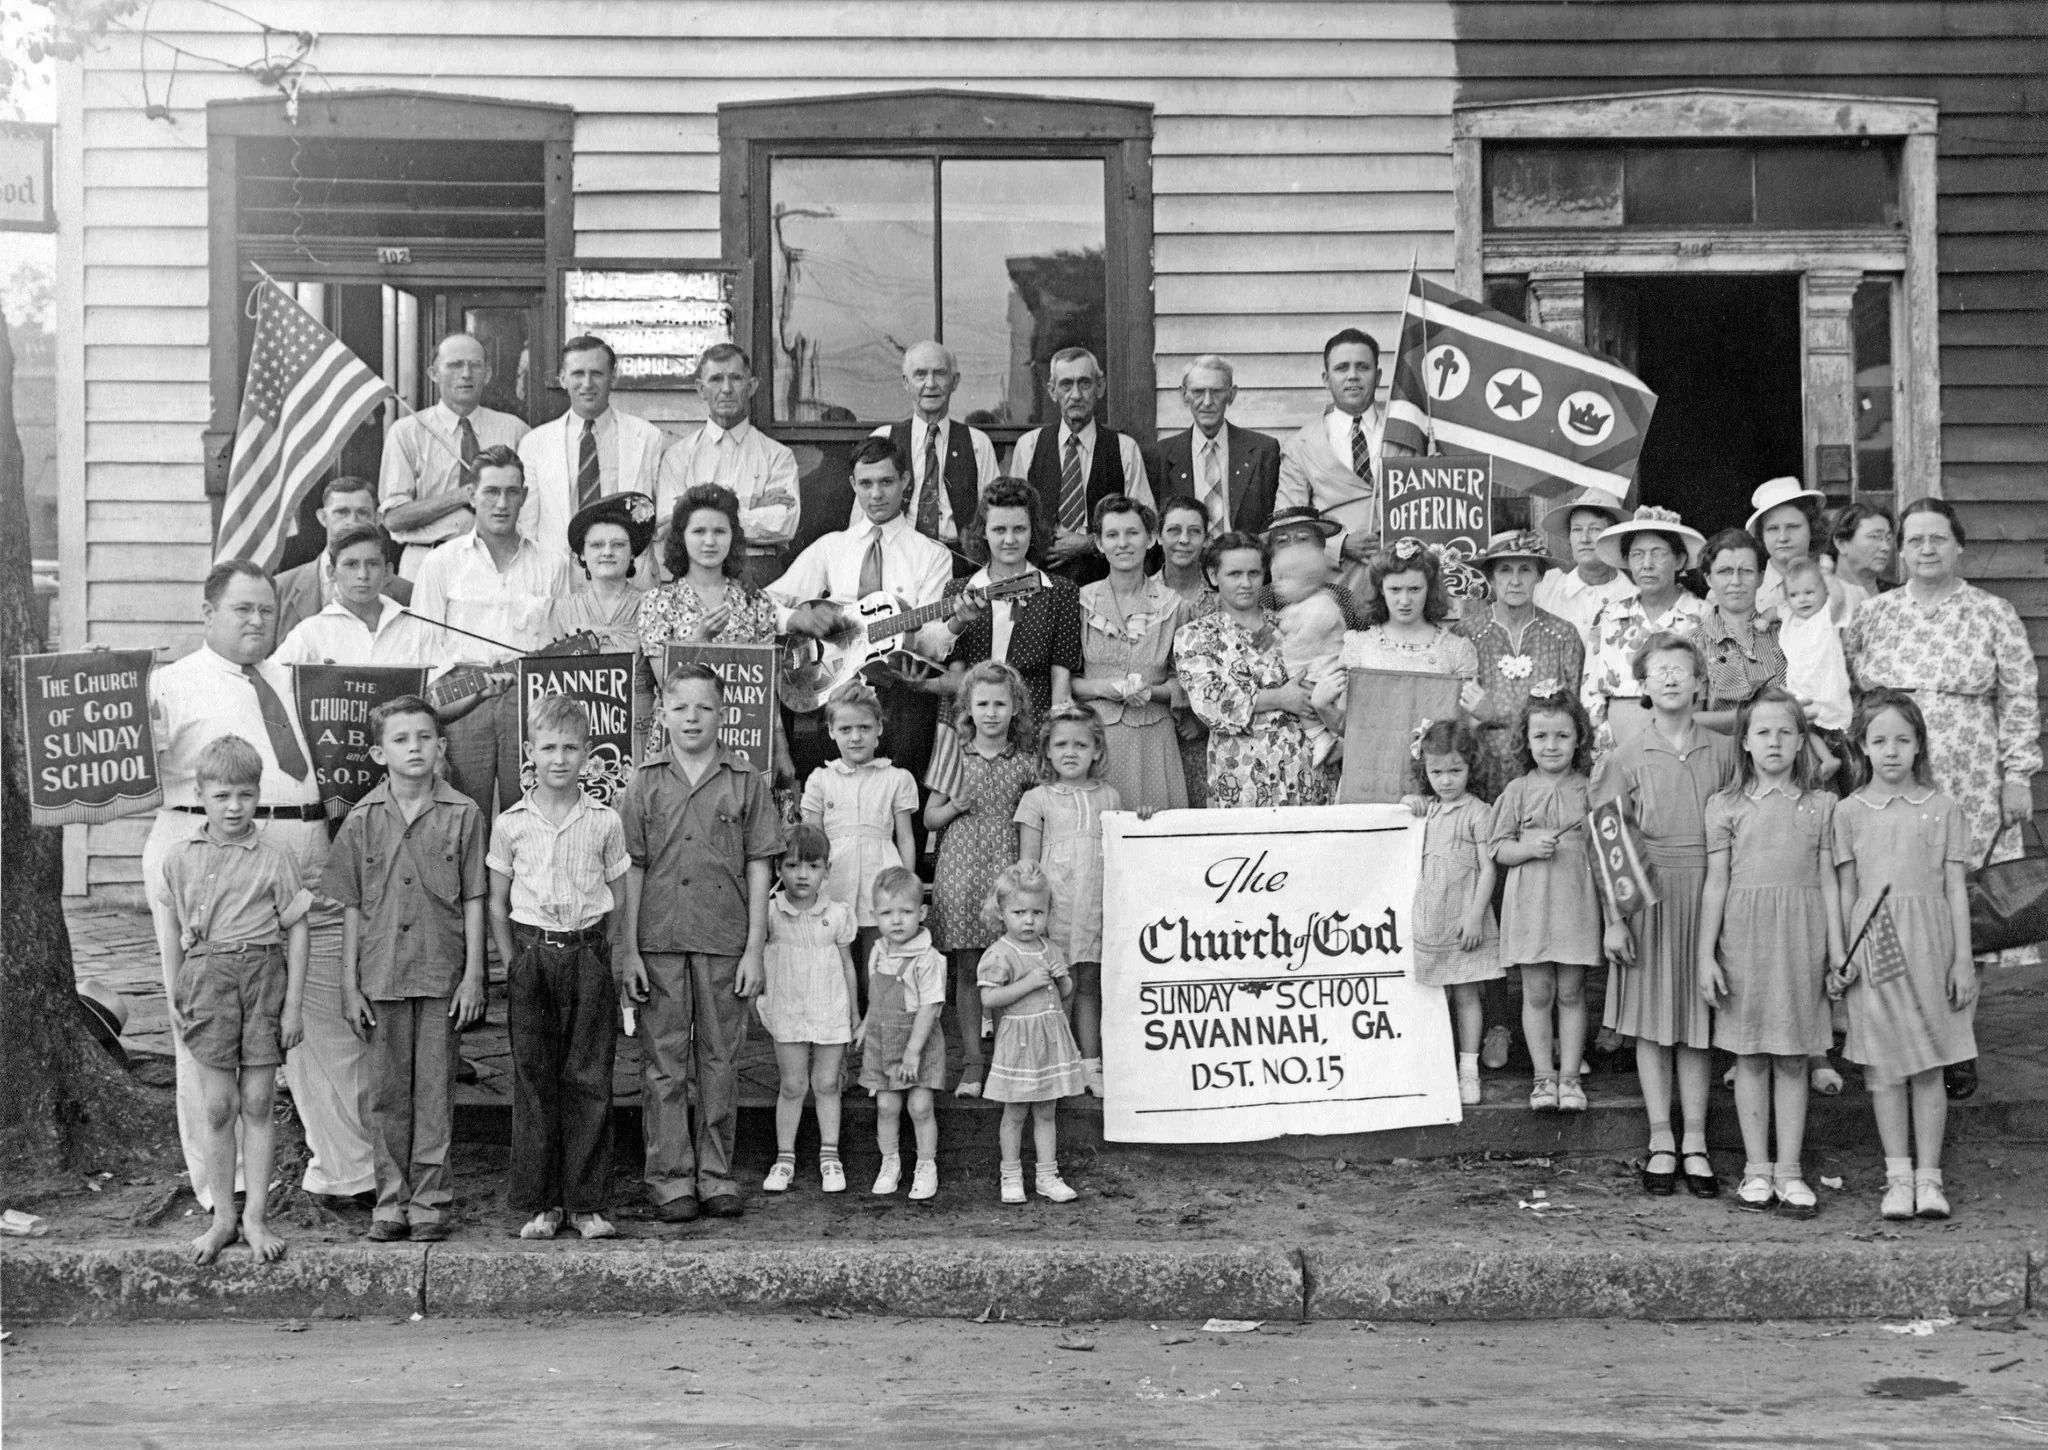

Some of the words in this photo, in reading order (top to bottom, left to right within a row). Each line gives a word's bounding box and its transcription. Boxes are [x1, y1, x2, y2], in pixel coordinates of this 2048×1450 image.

[0, 175, 36, 204] od
[1388, 467, 1485, 501] BANNER
[1390, 496, 1484, 531] OFFERING
[38, 675, 70, 698] THE
[74, 671, 138, 695] CHURCH
[344, 680, 376, 694] THE
[527, 668, 628, 706] BANNER
[678, 662, 764, 684] MENS
[48, 707, 75, 728] OF
[84, 701, 133, 724] GOD
[311, 698, 368, 724] CHURCH
[43, 725, 143, 759] SUNDAY
[346, 751, 370, 762] and
[41, 755, 150, 792] SCHOOL
[1205, 850, 1289, 903] The
[1139, 912, 1294, 964] Church
[1287, 911, 1319, 971] of
[1313, 906, 1402, 957] God
[1139, 982, 1237, 1015] SUNDAY
[1276, 977, 1389, 1009] SCHOOL
[1144, 1013, 1329, 1050] SAVANNAH,
[1351, 1010, 1402, 1040] GA.
[1191, 1060, 1254, 1091] DST.
